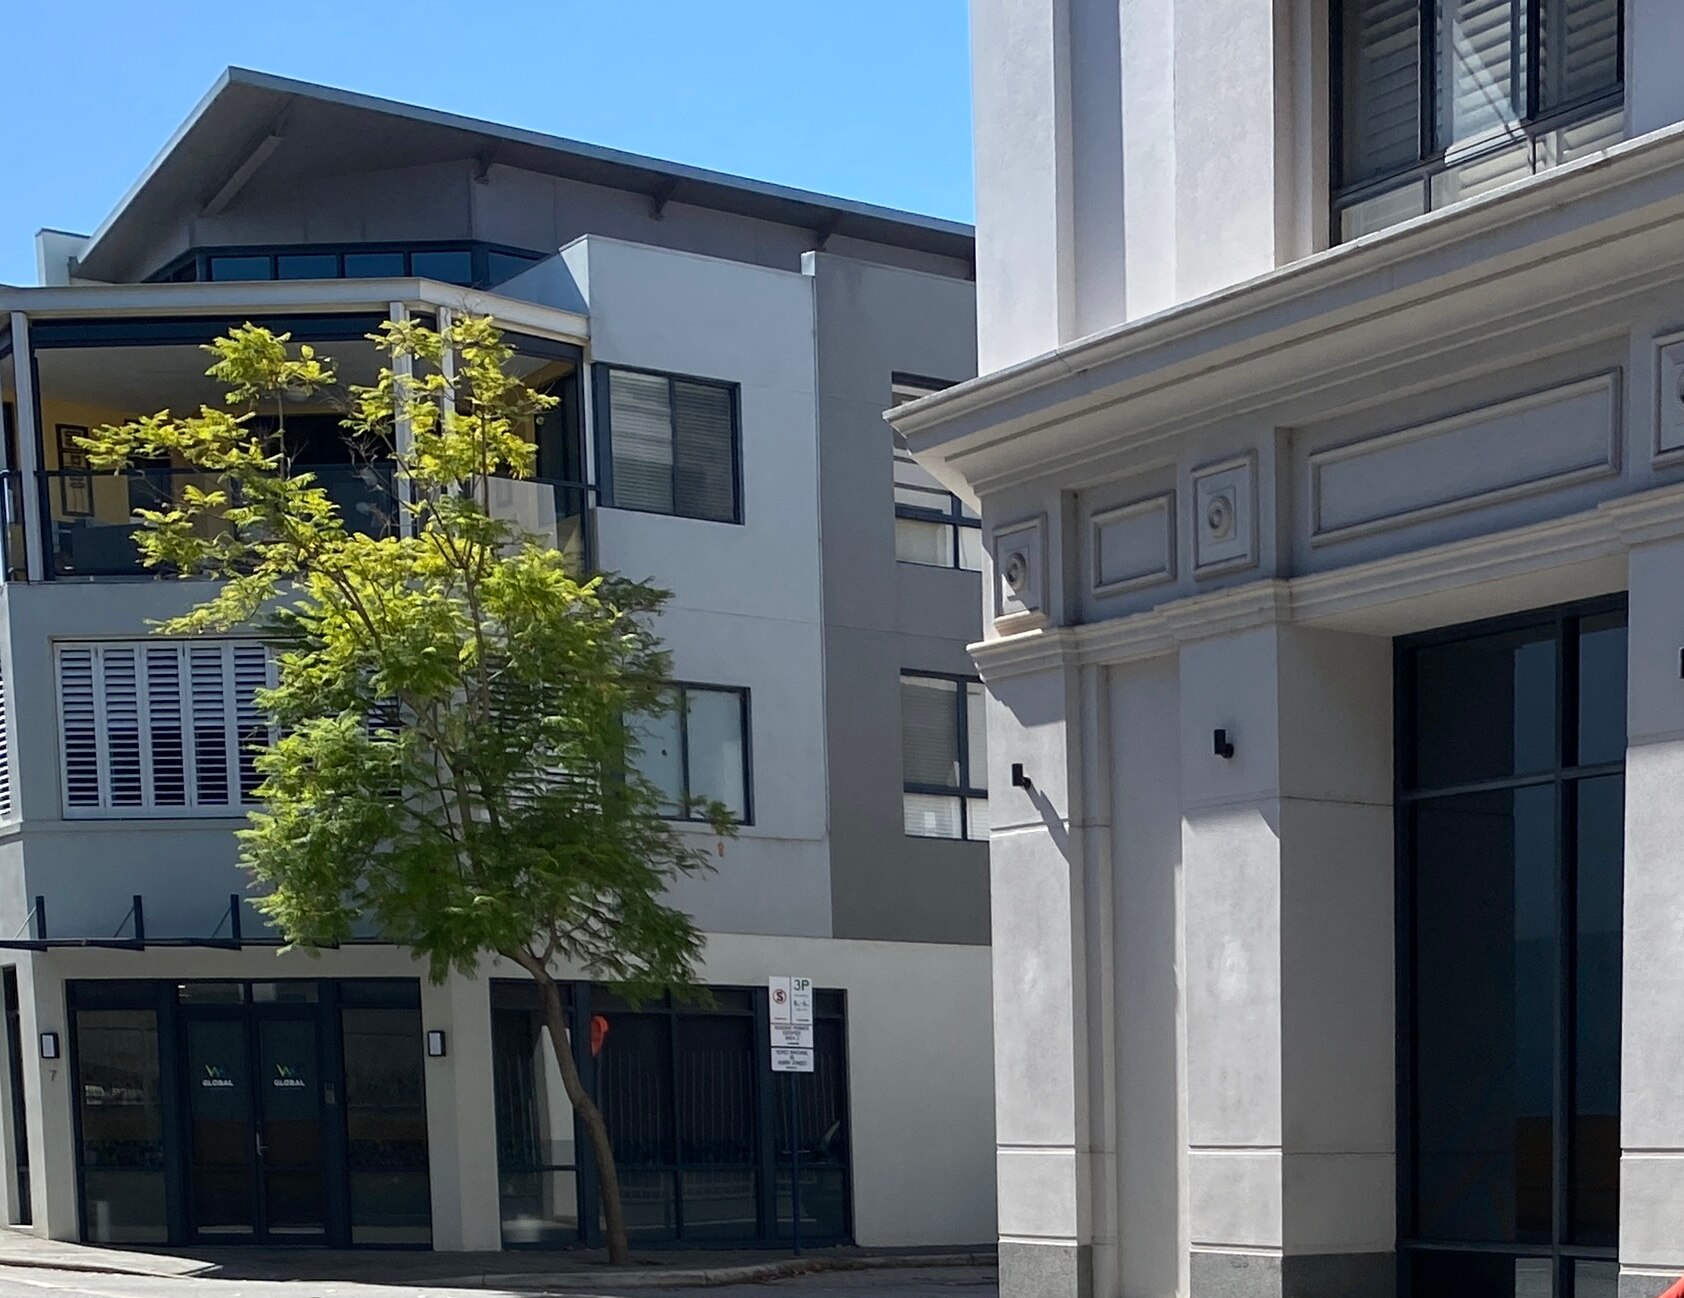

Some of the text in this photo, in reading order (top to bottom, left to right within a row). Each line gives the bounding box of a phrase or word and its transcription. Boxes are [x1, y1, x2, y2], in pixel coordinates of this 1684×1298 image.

[794, 979, 809, 991] 3P
[202, 1079, 234, 1087] GLOBAL
[274, 1079, 305, 1087] GLOBAL
